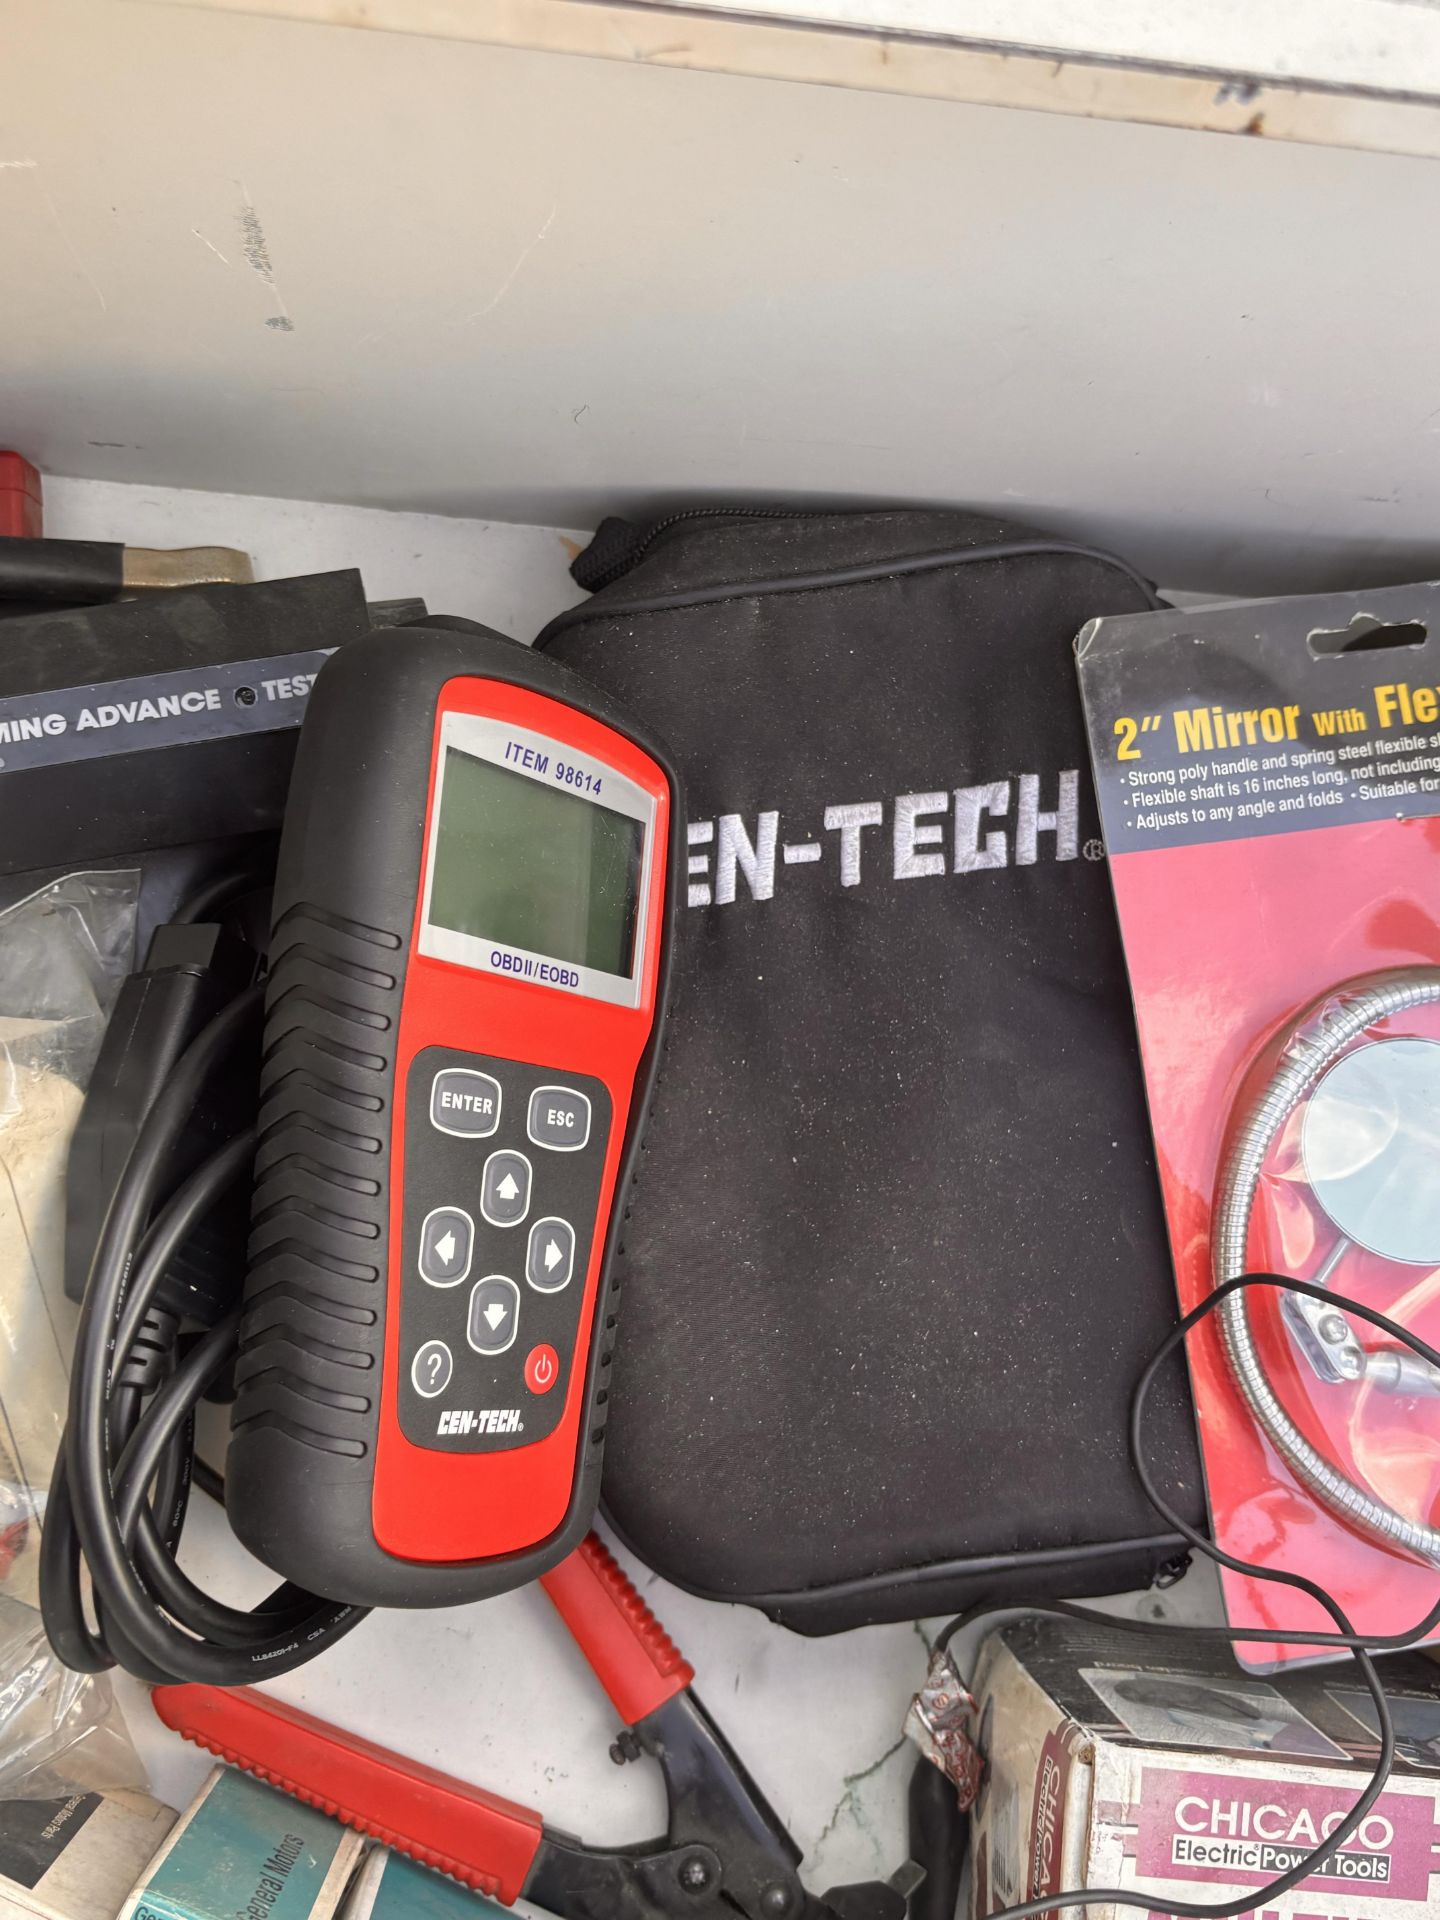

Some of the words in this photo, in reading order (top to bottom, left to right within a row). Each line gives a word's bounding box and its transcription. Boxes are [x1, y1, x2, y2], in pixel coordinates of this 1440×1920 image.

[76, 689, 222, 731] ADVANCE
[1173, 705, 1300, 753] Mirror
[1312, 707, 1367, 736] With
[1374, 683, 1440, 728] Fle
[505, 742, 549, 774] ITEM
[555, 762, 602, 795] 98614
[1128, 769, 1175, 787] Strong
[1179, 763, 1208, 783] poly
[1212, 757, 1258, 776] handle
[1262, 755, 1287, 769] and
[1291, 749, 1335, 769] spring
[1338, 741, 1373, 760] steel
[1375, 735, 1427, 755] flexible
[1132, 788, 1186, 807] Flexible
[1190, 783, 1225, 800] shaft
[1228, 781, 1240, 796] is
[1244, 778, 1260, 794] 16
[1263, 774, 1309, 792] inches
[1312, 770, 1348, 786] long,
[1351, 764, 1375, 780] not
[1376, 756, 1440, 776] including
[1136, 811, 1189, 831] Adjusts
[1192, 808, 1206, 823] to
[1209, 806, 1233, 821] any
[1237, 799, 1275, 818] angle
[1279, 795, 1305, 811] and
[1308, 789, 1344, 807] folds
[1359, 779, 1417, 800] Suitable
[1420, 776, 1440, 792] for
[491, 951, 579, 987] OBDII/EOBD
[442, 1091, 493, 1115] ENTER
[547, 1109, 575, 1128] ESC
[263, 1833, 304, 1878] Motors
[1334, 1854, 1388, 1879] Tools
